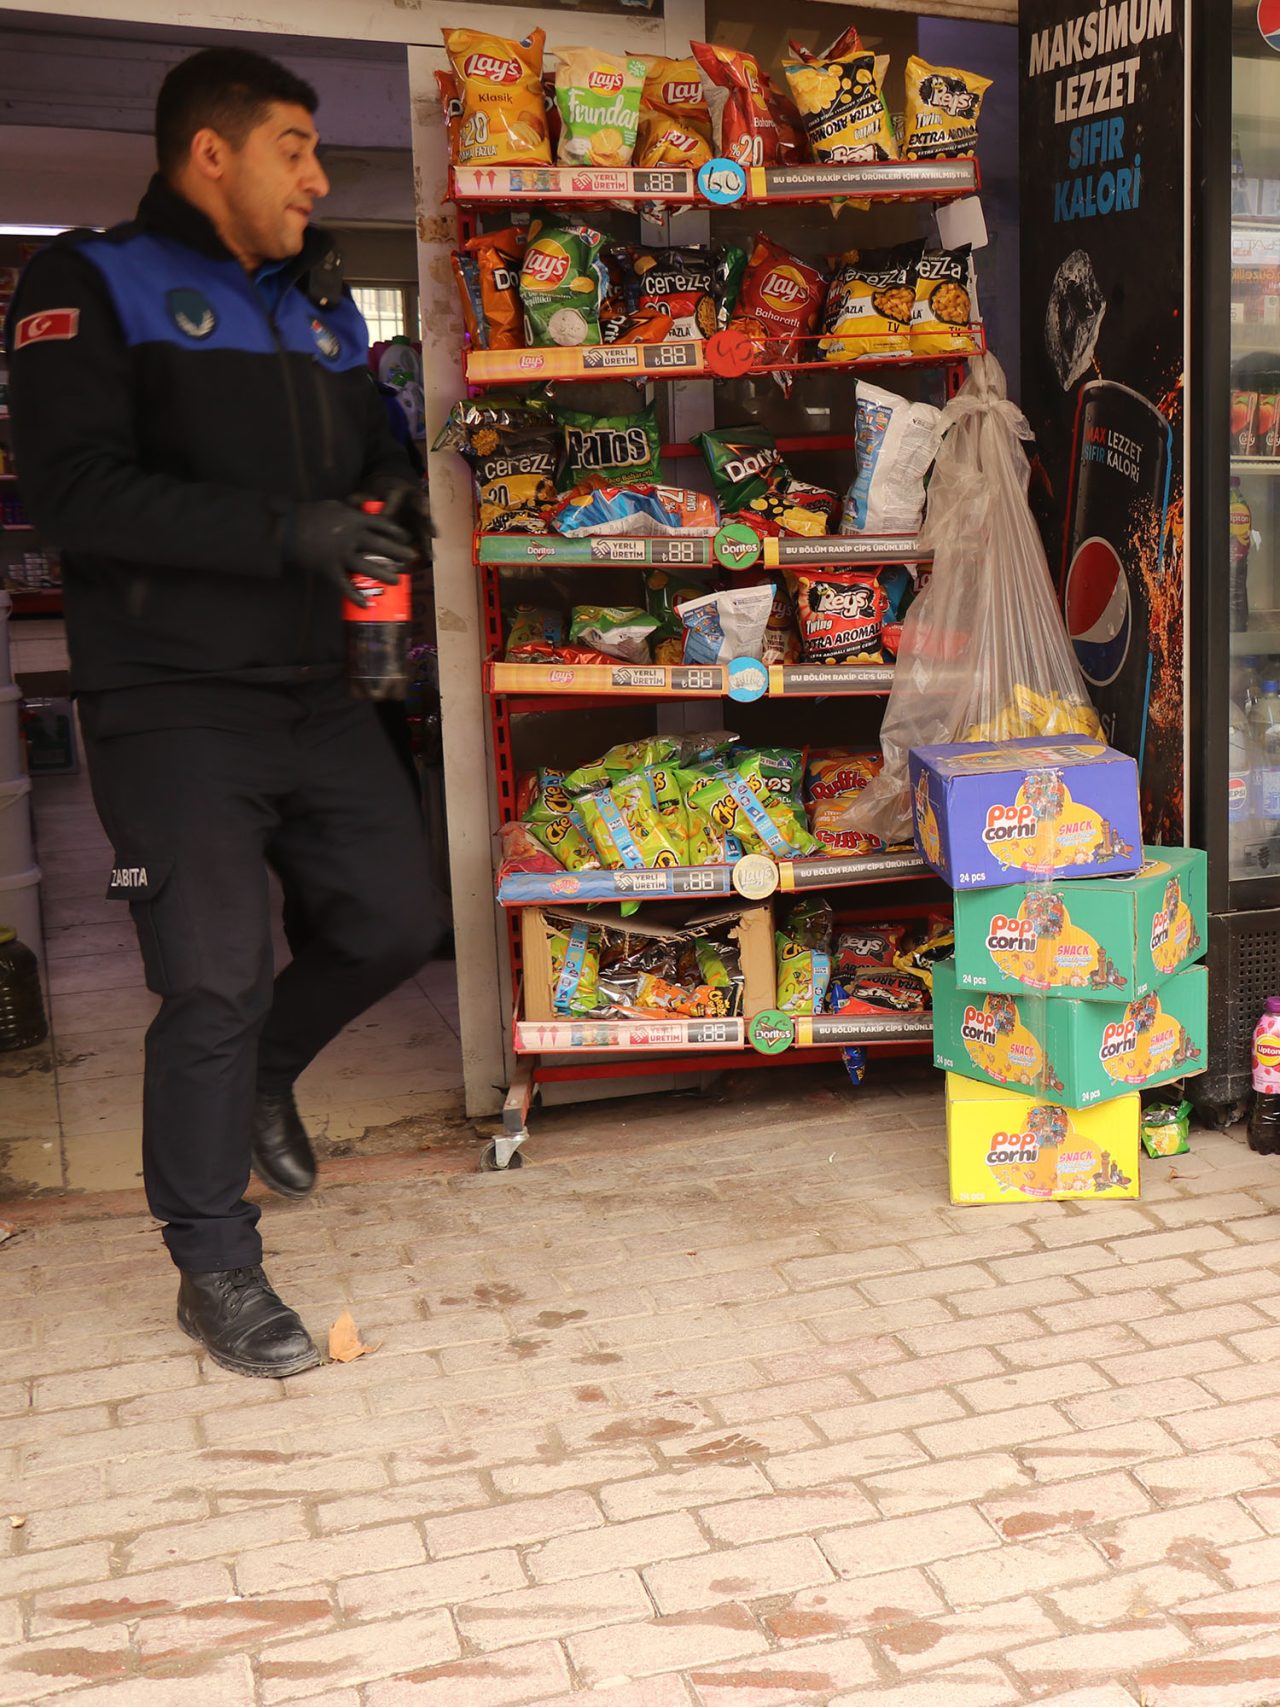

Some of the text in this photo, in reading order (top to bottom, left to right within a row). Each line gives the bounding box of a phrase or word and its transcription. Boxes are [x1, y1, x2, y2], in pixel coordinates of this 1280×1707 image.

[1029, 0, 1172, 77] MAKSİMUM
[467, 54, 521, 83] Lay's
[590, 70, 624, 90] Lay's
[478, 93, 513, 104] Klasik
[667, 82, 703, 104] Lay
[1055, 57, 1140, 124] LEZZET
[908, 130, 945, 145] EXTRA
[1069, 117, 1124, 169] SIFIR
[593, 173, 618, 181] YERLİ
[593, 181, 625, 191] ÜRETİM
[773, 176, 785, 184] BU
[786, 174, 815, 184] BÖLÜM
[816, 173, 841, 182] RAKİP
[842, 171, 860, 182] CİPS
[862, 170, 902, 181] ÜRÜNLERİ
[1054, 154, 1141, 223] KALORİ
[523, 248, 567, 281] Lay's
[918, 256, 962, 280] ezza
[845, 266, 908, 286] erezza
[764, 273, 807, 300] Lay's
[755, 306, 801, 328] Baharatlı
[845, 304, 864, 315] AZLA
[604, 349, 629, 357] YERLİ
[604, 356, 636, 365] ÜRETİM
[1108, 430, 1142, 463] LEZZET
[1107, 450, 1140, 483] KALORİ
[612, 549, 644, 559] ÜRETİM
[722, 543, 757, 555] Doritos
[786, 546, 798, 554] BU
[799, 544, 827, 554] BÖLÜM
[828, 543, 852, 553] RAKİP
[853, 542, 872, 553] CİPS
[834, 623, 882, 646] AROMAL
[633, 675, 663, 685] ÜRETİM
[803, 672, 831, 681] BÖLÜM
[833, 671, 856, 681] RAKİP
[810, 768, 870, 800] Ruffle
[988, 805, 1033, 827] pop
[985, 818, 1036, 841] corni
[1059, 820, 1093, 835] SNACK
[111, 867, 148, 887] ZABITA
[801, 870, 812, 878] BU
[813, 868, 841, 877] BÖLÜM
[842, 864, 866, 874] RAKİP
[866, 862, 884, 872] CİPS
[960, 872, 986, 884] 24 pcs
[991, 915, 1034, 936] pop
[987, 933, 1038, 950] corni
[1058, 945, 1089, 956] SNACK
[963, 974, 987, 986] 24 pcs
[820, 1021, 933, 1034] BU BÖLÜM RAKİP CİPS ÜRÜNLE
[965, 1007, 994, 1030] pop
[755, 1027, 791, 1039] Doritos
[962, 1024, 995, 1044] corni
[1105, 1021, 1135, 1045] pop
[1101, 1035, 1136, 1058] corni
[992, 1133, 1036, 1151] pop
[987, 1145, 1037, 1163] corni
[1060, 1151, 1092, 1162] SNACK
